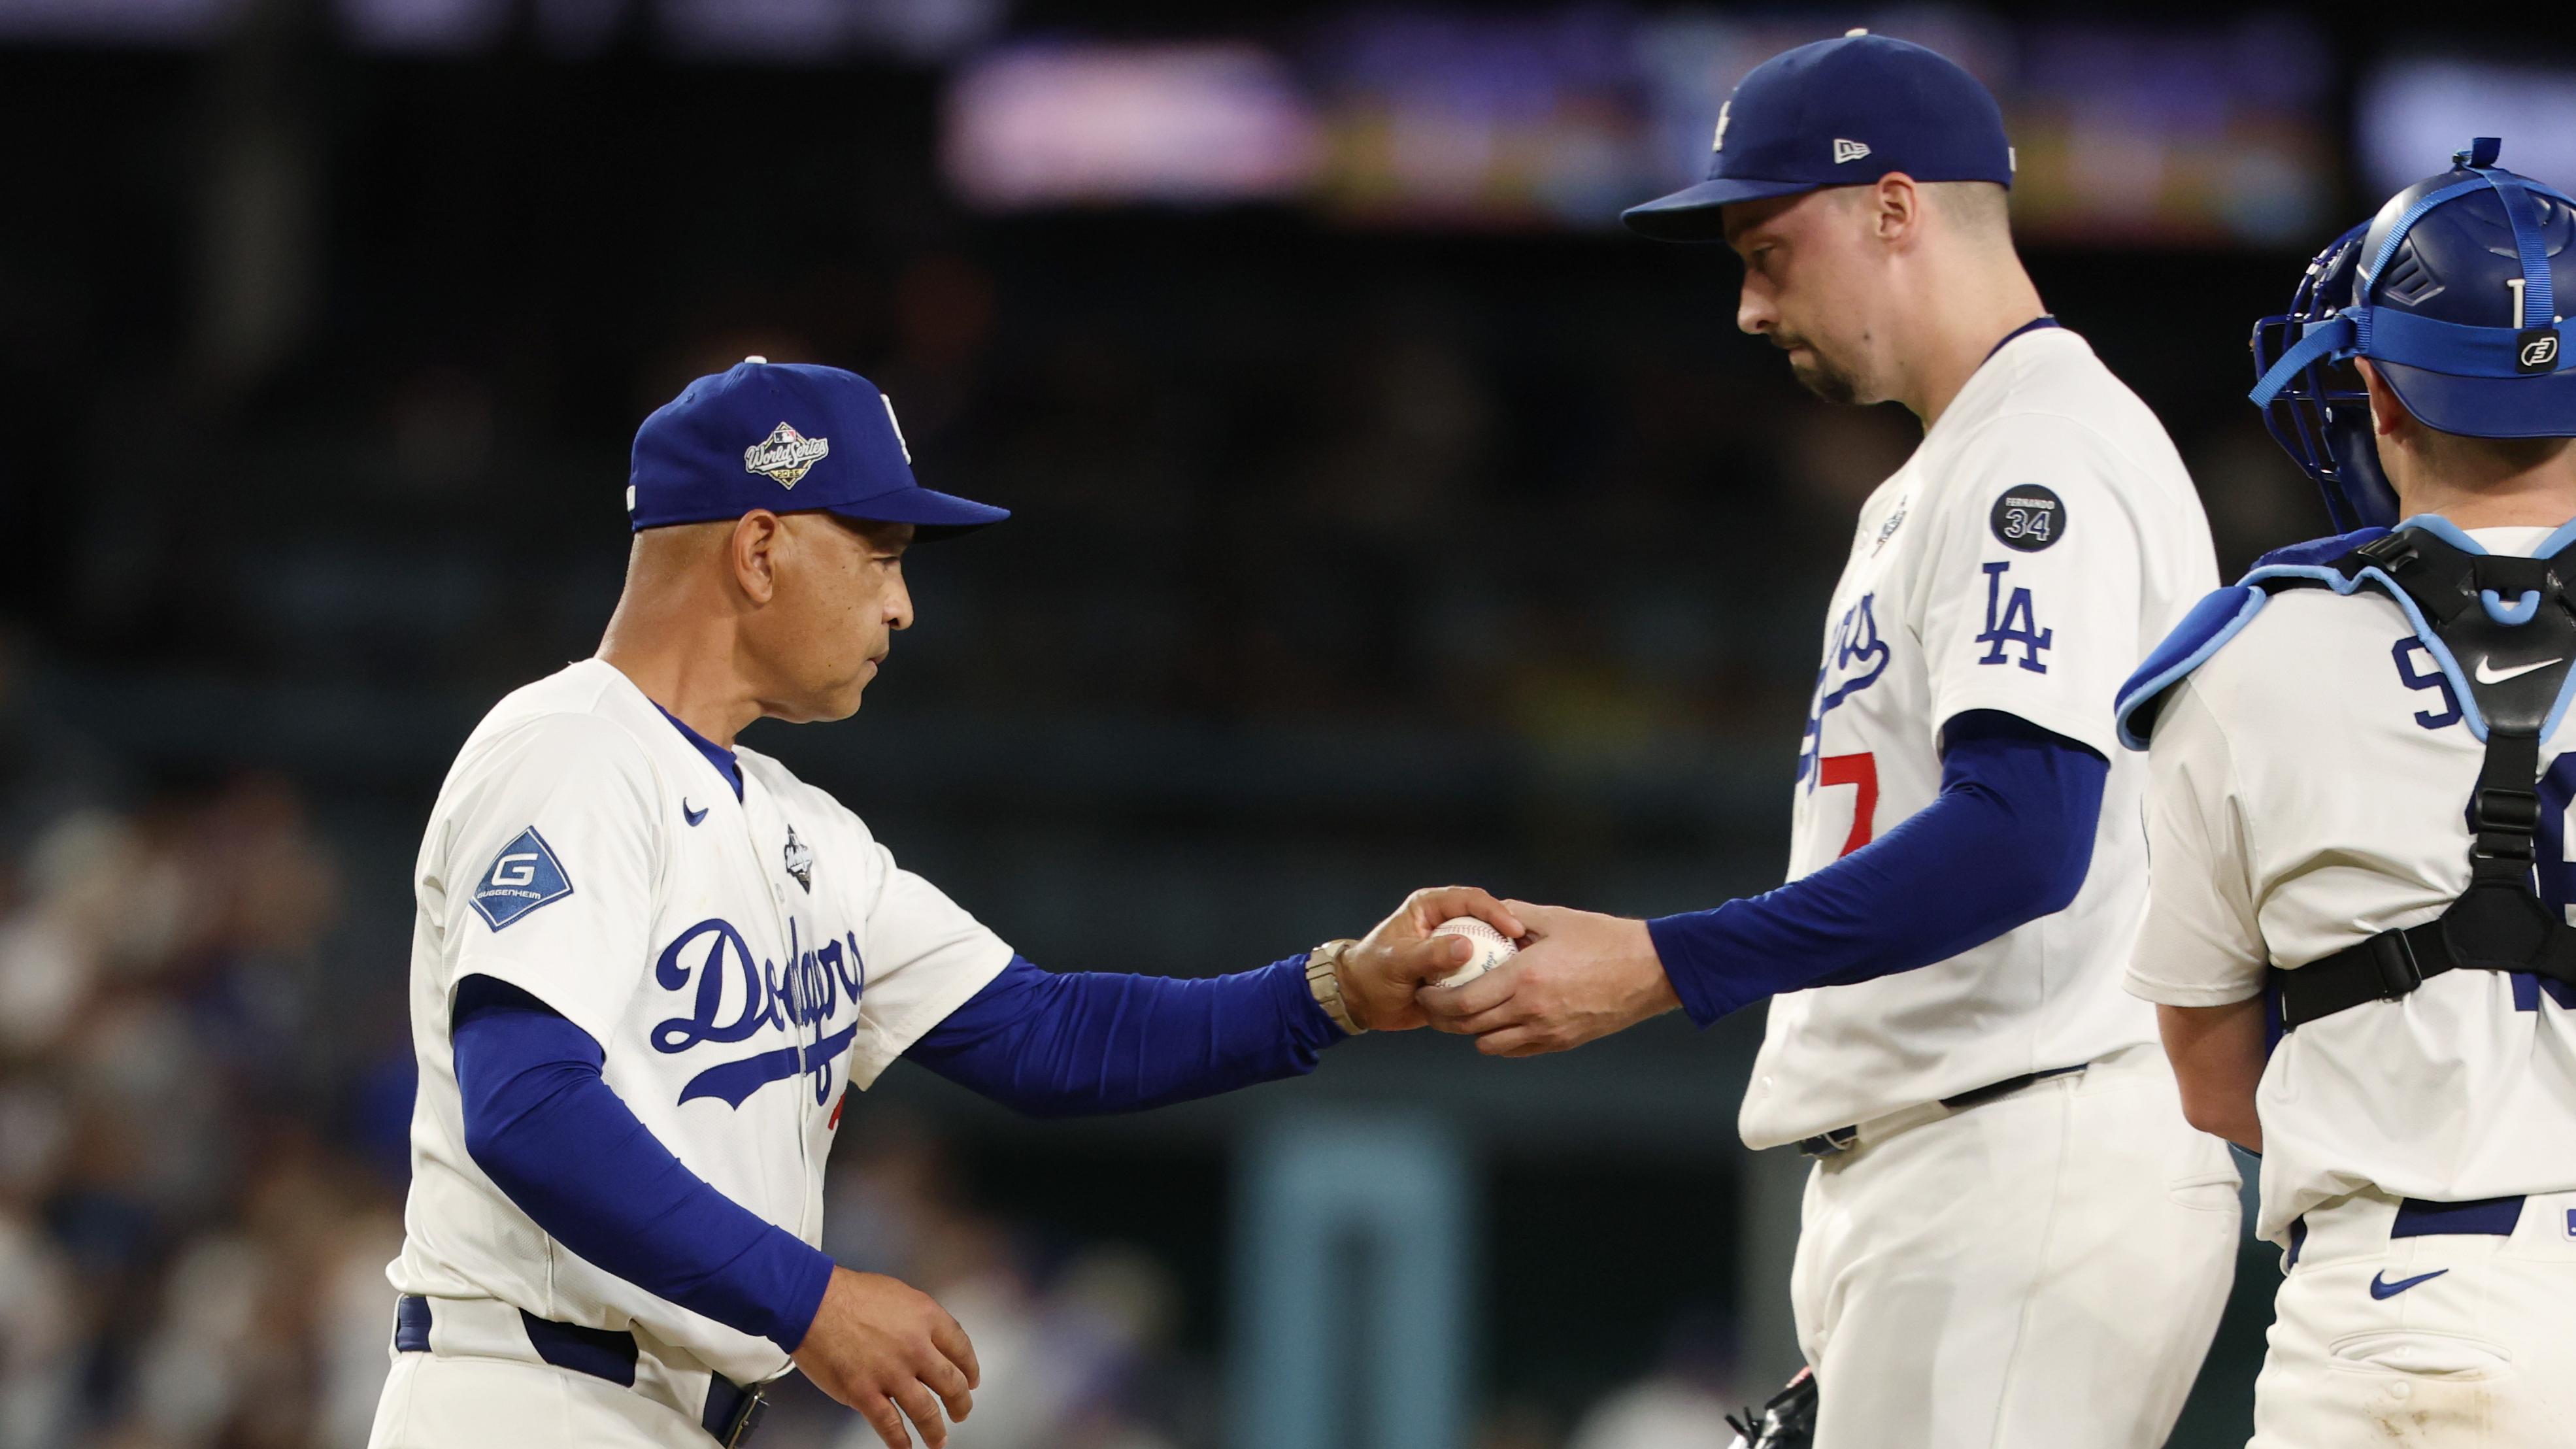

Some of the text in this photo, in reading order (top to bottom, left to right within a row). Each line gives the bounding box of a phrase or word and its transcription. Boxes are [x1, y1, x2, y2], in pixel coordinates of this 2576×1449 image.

[746, 439, 826, 469] World Series
[2003, 508, 2051, 541] 34
[1975, 561, 2053, 675] LA
[491, 852, 539, 886] G
[477, 889, 541, 899] GUGGENHEIM
